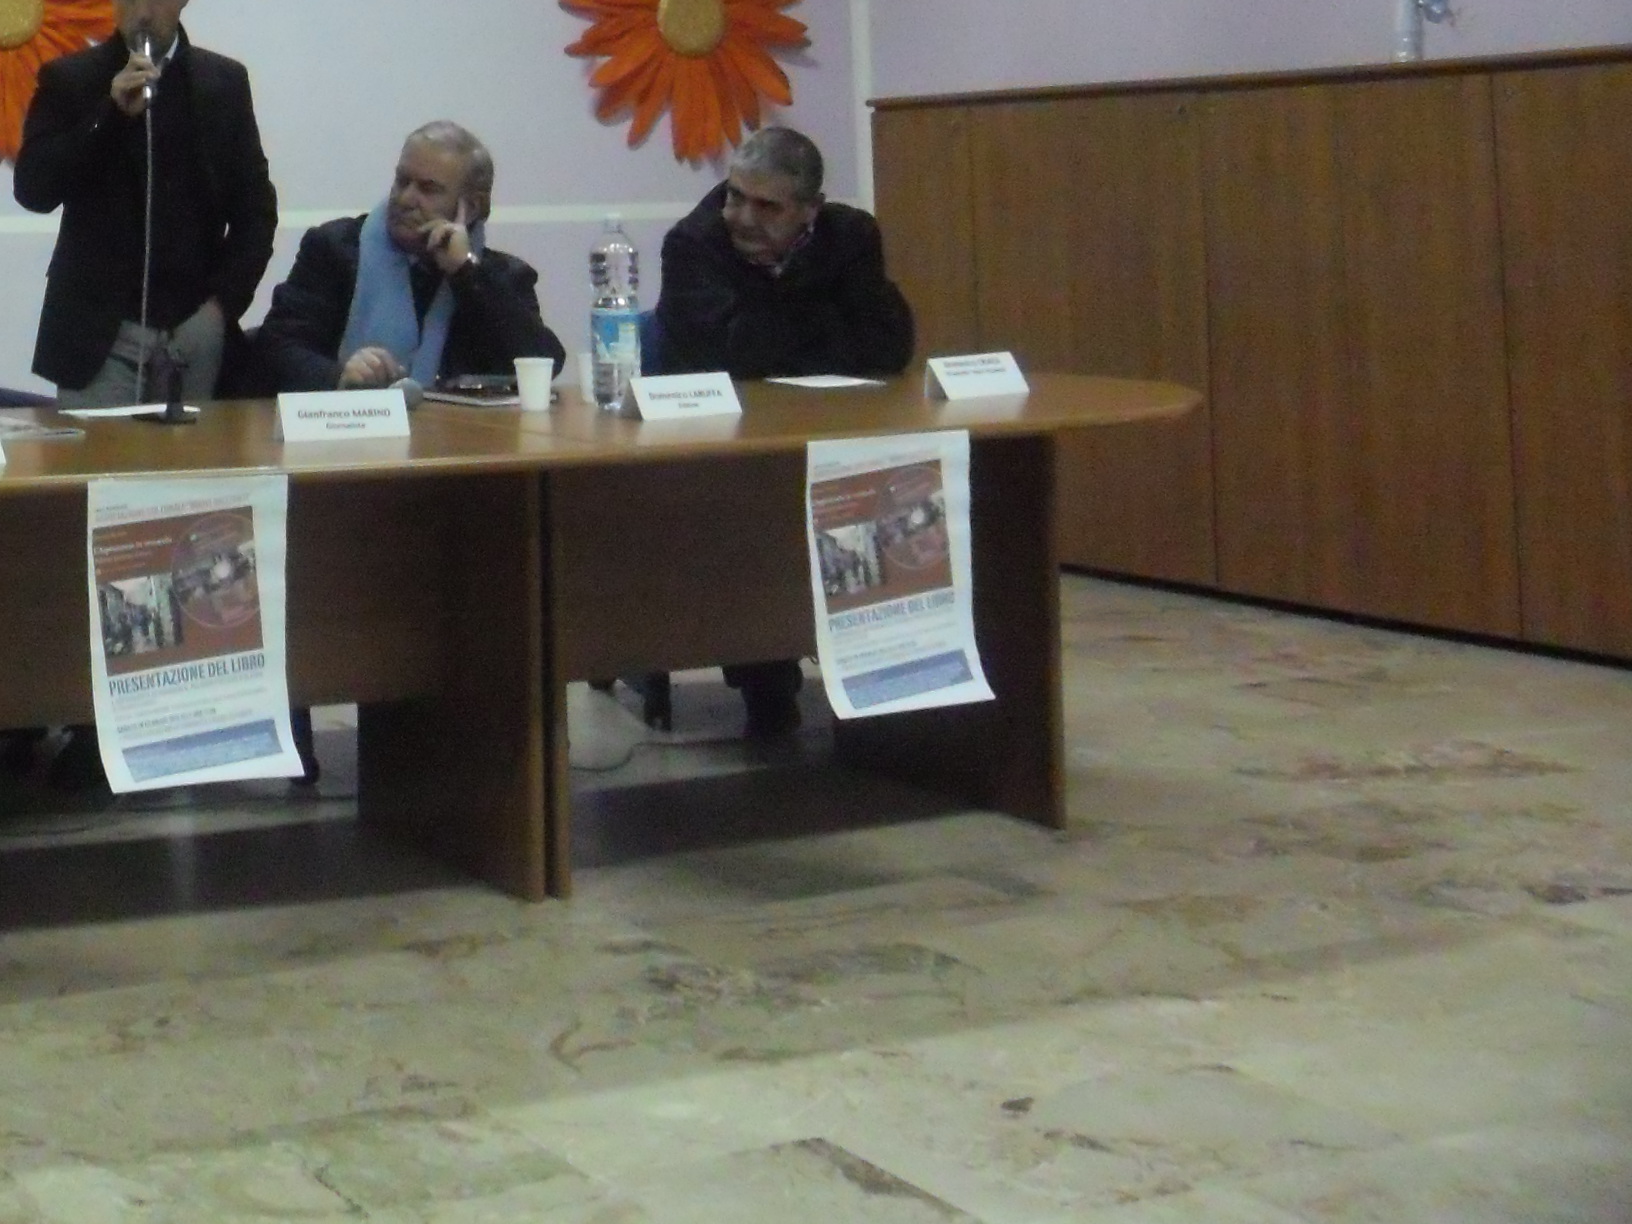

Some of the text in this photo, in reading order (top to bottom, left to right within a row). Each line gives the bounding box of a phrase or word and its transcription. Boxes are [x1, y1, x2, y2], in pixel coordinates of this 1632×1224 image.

[108, 663, 207, 697] PRESENTAZIONE
[208, 660, 229, 678] DEL
[231, 652, 265, 673] LIBRO
